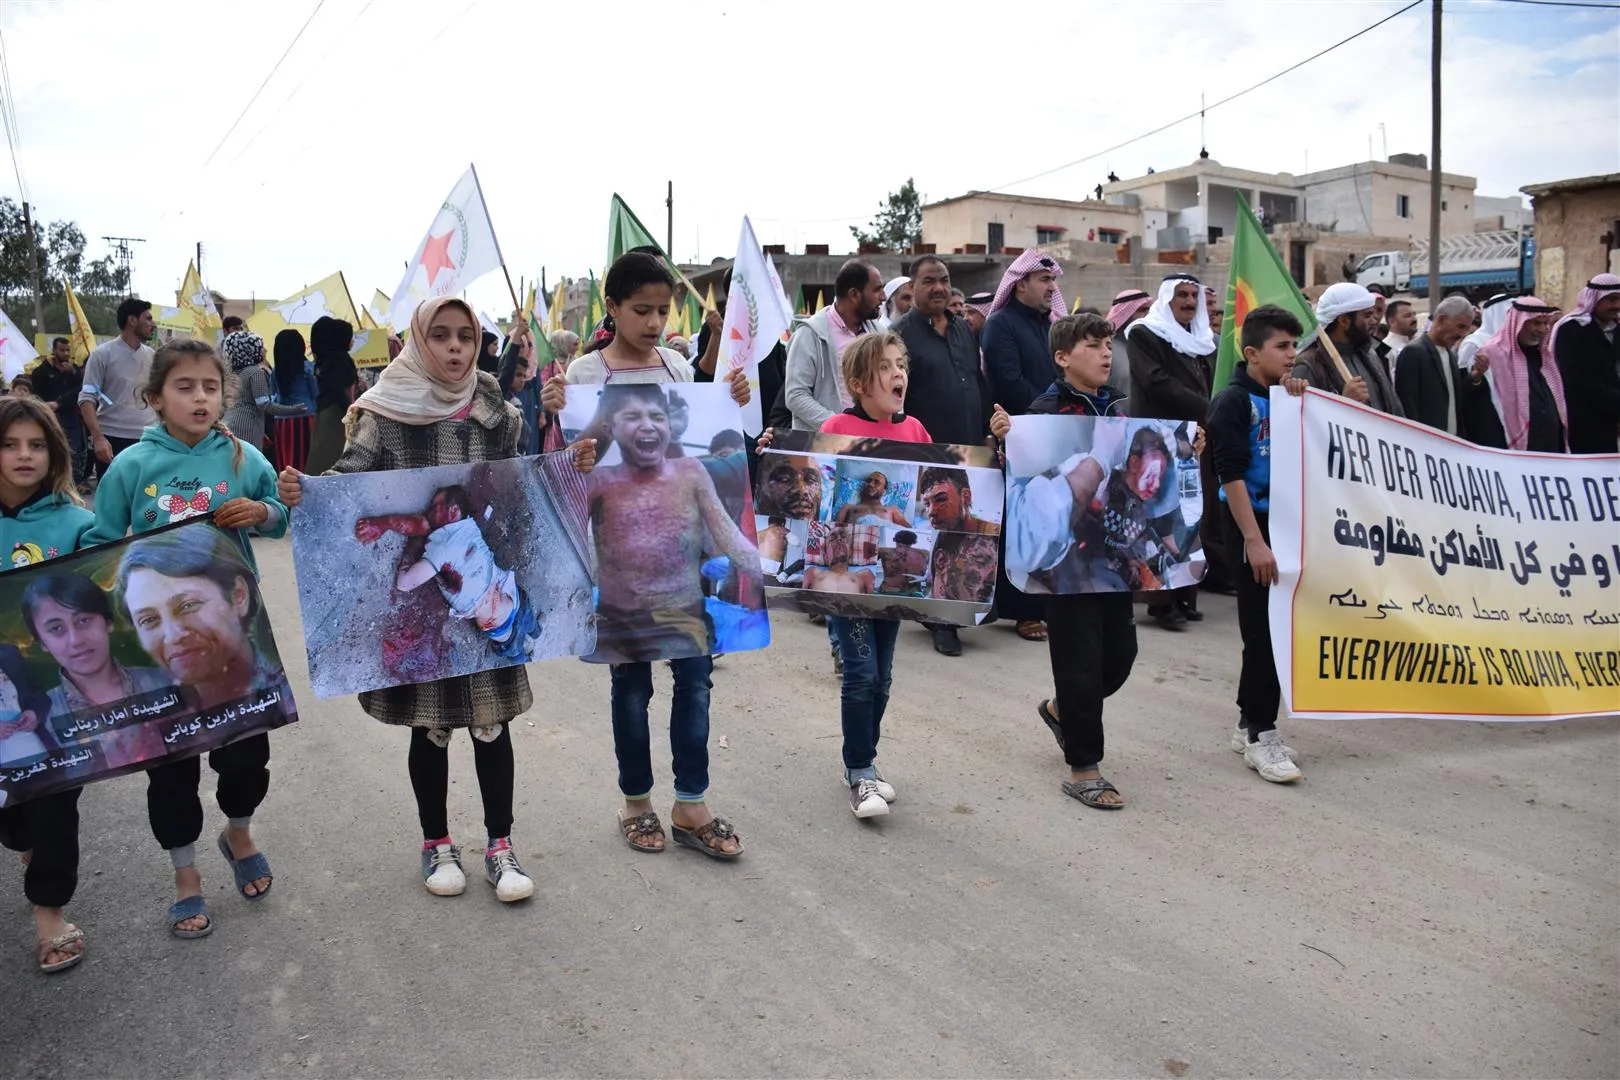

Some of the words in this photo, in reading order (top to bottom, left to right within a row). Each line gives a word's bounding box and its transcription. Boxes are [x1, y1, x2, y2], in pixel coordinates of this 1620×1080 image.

[1327, 421, 1376, 487] HER
[1377, 438, 1423, 500] DER
[1424, 453, 1521, 524] ROJAVA,
[1521, 474, 1579, 522] HER
[1582, 477, 1620, 523] DE
[1333, 507, 1425, 567] مقاومة
[1430, 523, 1505, 576] الأماكن
[1509, 540, 1542, 586] كل
[1318, 635, 1479, 686] EVERYWHERE
[1478, 646, 1504, 686] IS
[1499, 648, 1581, 692] ROJAVA,
[1574, 650, 1620, 687] EVER
[101, 707, 129, 725] امارا
[131, 693, 179, 717] الشهيدة
[237, 691, 281, 715] الشهيدة
[164, 715, 202, 744] كوباني
[206, 708, 236, 729] بارين
[49, 748, 93, 768] الشهيدة
[11, 761, 48, 782] هفرين
